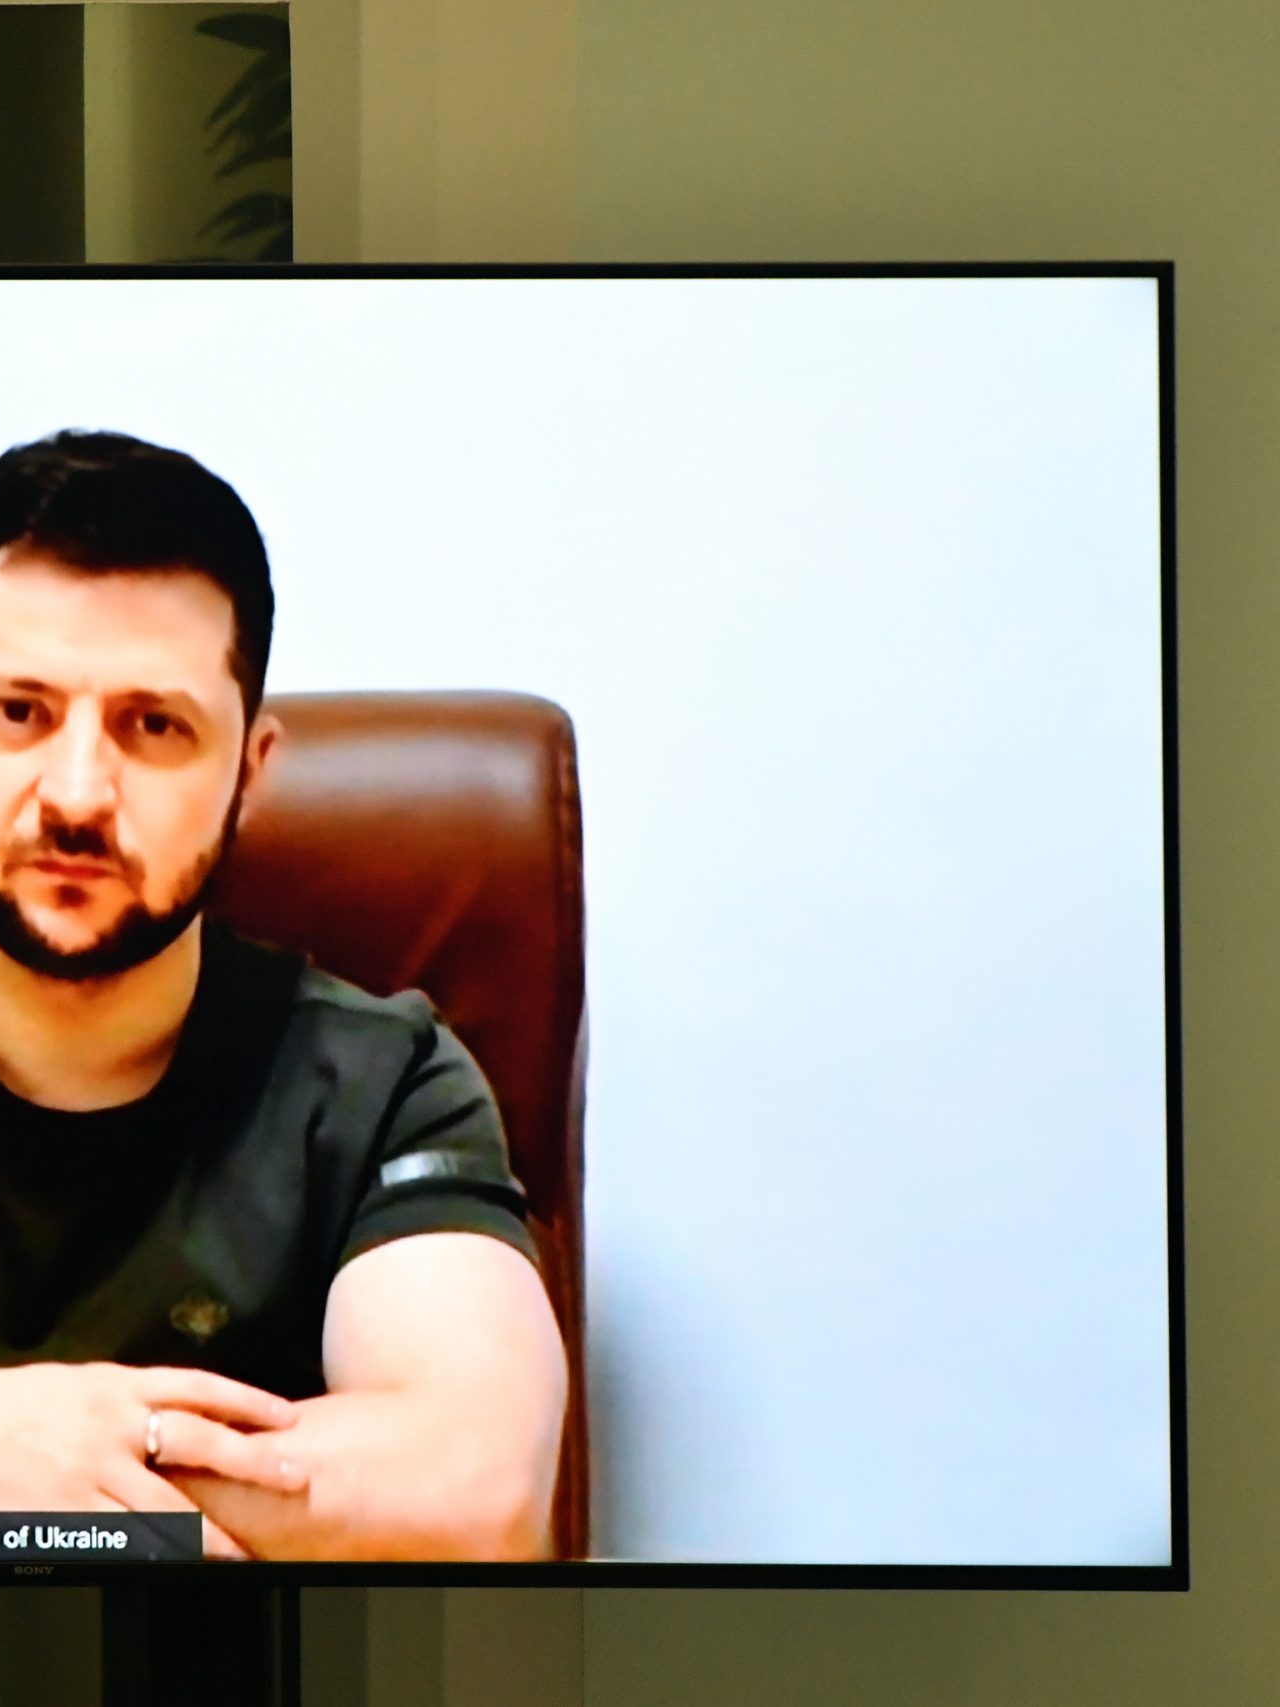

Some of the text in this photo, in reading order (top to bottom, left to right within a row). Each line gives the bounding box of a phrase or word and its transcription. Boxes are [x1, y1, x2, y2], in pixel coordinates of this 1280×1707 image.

[4, 1525, 29, 1549] of
[35, 1526, 128, 1549] Ukraine
[14, 1566, 54, 1575] SONY
